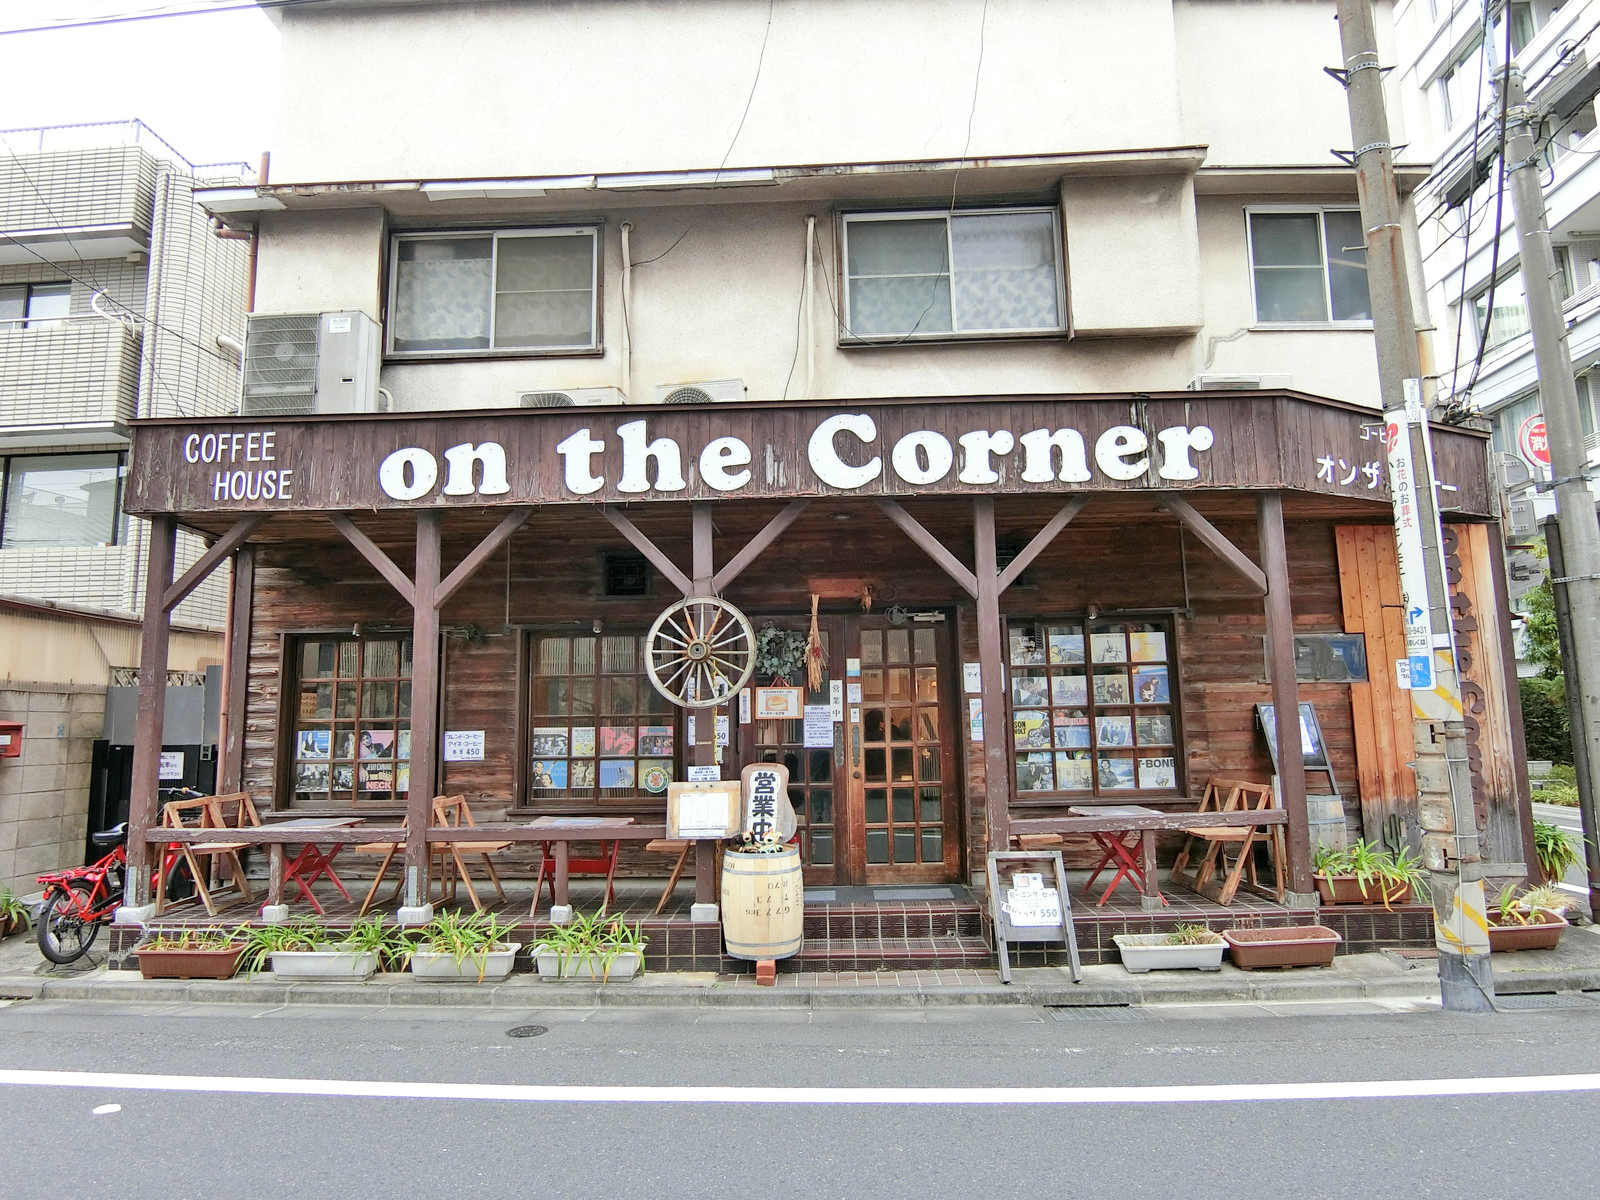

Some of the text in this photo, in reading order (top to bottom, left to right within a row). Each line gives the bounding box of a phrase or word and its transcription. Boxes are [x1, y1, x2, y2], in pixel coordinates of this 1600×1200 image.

[185, 431, 277, 464] COFFEE
[379, 413, 1214, 501] on the Corner
[213, 469, 294, 501] HOUSE
[1395, 457, 1413, 529] お花のお葬式
[365, 780, 391, 790] NECK
[751, 770, 777, 843] 営業中
[1040, 908, 1058, 918] 550
